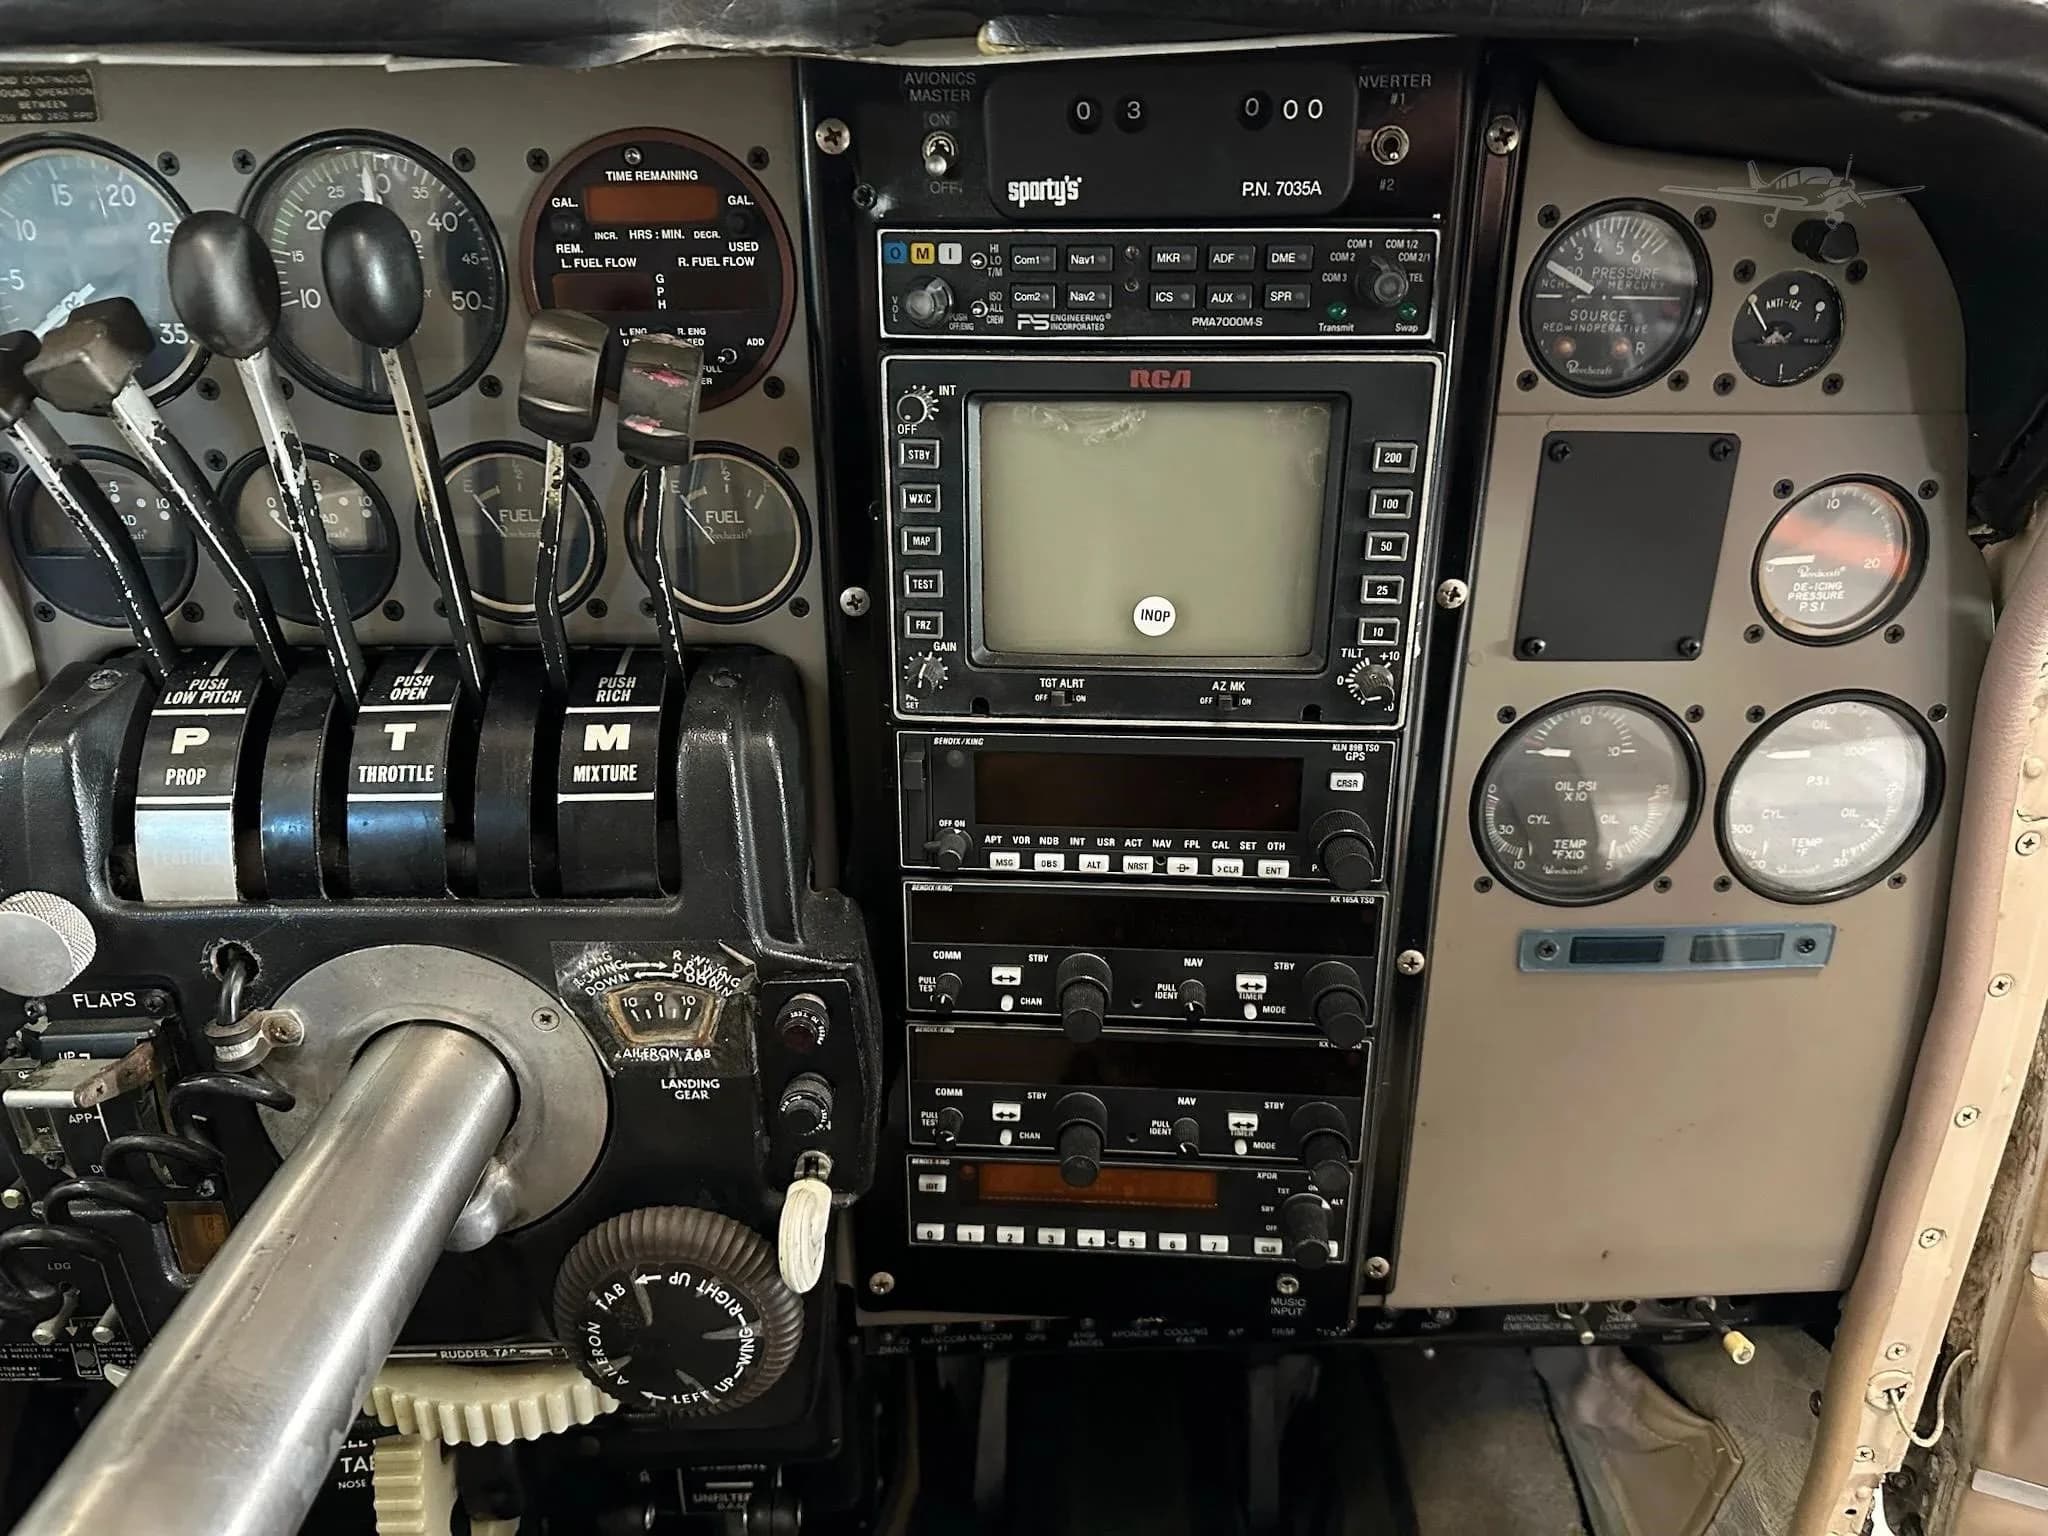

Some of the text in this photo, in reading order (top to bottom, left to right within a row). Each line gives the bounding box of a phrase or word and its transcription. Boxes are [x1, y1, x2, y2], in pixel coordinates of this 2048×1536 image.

[904, 72, 976, 85] AVIONICS
[1358, 74, 1432, 89] NVERTER
[909, 89, 971, 103] MASTER
[1127, 101, 1141, 119] 3
[929, 114, 950, 127] ON
[606, 170, 698, 181] TIME REMAINING
[1276, 181, 1322, 196] 7035A
[1379, 178, 1395, 191] #2
[51, 184, 73, 206] 15
[106, 184, 136, 206] 20
[327, 186, 345, 199] 25
[412, 187, 429, 199] 35
[1008, 175, 1082, 208] sporty's
[552, 198, 579, 208] GAL.
[727, 195, 754, 206] GAL.
[427, 212, 458, 232] 40
[16, 220, 37, 241] 10
[629, 229, 686, 240] HRS MIN.
[694, 230, 721, 240] DECR.
[594, 231, 619, 241] INCR.
[556, 244, 584, 254] REM.
[728, 241, 759, 252] USED
[1615, 241, 1625, 255] 5
[292, 251, 304, 262] 15
[461, 253, 480, 265] 45
[1070, 254, 1095, 264] Nav1
[1157, 252, 1180, 263] MKR
[1213, 253, 1234, 263] ADF
[1271, 252, 1295, 263] DME
[1574, 247, 1583, 261] 3
[1631, 251, 1642, 264] 6
[574, 257, 637, 268] FUEL FLOW
[692, 256, 755, 267] FUEL FLOW
[1014, 255, 1040, 265] Com1
[1592, 267, 1662, 280] PRESSURE
[1608, 279, 1665, 290] MERCURY
[300, 288, 321, 309] 10
[451, 291, 481, 311] 50
[1014, 292, 1041, 302] Com2
[1070, 292, 1096, 301] Nav2
[1156, 292, 1174, 302] ICS
[1211, 293, 1233, 303] AUX
[1270, 291, 1292, 301] SPR
[1766, 299, 1802, 311] ANTI-ICE
[1051, 314, 1105, 322] ENGINEERING
[1569, 309, 1628, 322] SOURCE
[1051, 322, 1105, 331] INCORPORATED
[1192, 316, 1263, 327] PMA7000M-S
[688, 327, 706, 336] ENG
[1318, 322, 1354, 332] Transmit
[1395, 323, 1419, 333] Swap
[160, 323, 190, 345] 35
[746, 338, 765, 346] ADD
[1130, 369, 1192, 389] RCA
[938, 385, 957, 396] INT
[897, 424, 917, 435] OFF
[908, 450, 931, 460] STBY
[1384, 452, 1402, 463] 200
[1382, 499, 1398, 509] 100
[499, 510, 539, 523] FUEL
[705, 511, 744, 524] FUEL
[912, 536, 931, 546] MAP
[1380, 541, 1392, 552] 50
[1863, 559, 1880, 569] 20
[912, 580, 934, 590] TEST
[1793, 582, 1843, 592] DE-ICING
[1376, 586, 1388, 595] 25
[1788, 591, 1845, 600] PRESSURE
[1140, 608, 1171, 623] INOP
[915, 620, 932, 630] FRZ
[1373, 627, 1384, 637] 10
[933, 642, 957, 652] GAIN
[1341, 648, 1363, 658] TILT
[188, 678, 229, 691] PUSH
[393, 675, 434, 687] PUSH
[598, 676, 636, 689] PUSH
[1039, 678, 1085, 689] TGT ALRT
[1212, 681, 1245, 692] AZ MK
[164, 690, 243, 704] LOW PITCH
[390, 687, 433, 701] OPEN
[596, 689, 632, 702] RICH
[171, 727, 210, 754] P
[384, 723, 417, 751] T
[584, 724, 631, 750] M
[934, 737, 984, 746] BENDIX/KING
[1345, 752, 1366, 761] GPS
[165, 768, 207, 785] PROP
[358, 765, 435, 783] THROTTLE
[573, 764, 638, 782] MIXTURE
[1555, 781, 1597, 791] OIL PSI
[1761, 809, 1784, 819] CYL
[1527, 814, 1550, 825] CYL
[984, 835, 1002, 844] APT
[1013, 836, 1031, 845] VOR
[1039, 836, 1059, 846] NDB
[1070, 837, 1086, 846] INT
[1097, 837, 1115, 847] USR
[1124, 838, 1143, 847] ACT
[1153, 839, 1172, 848] NAV
[1184, 839, 1200, 849] FPL
[1554, 839, 1587, 849] TEMP
[1212, 840, 1230, 850] CAL
[1240, 841, 1257, 850] SET
[1267, 841, 1286, 851] OTH
[933, 951, 961, 960] COMM
[1028, 954, 1049, 963] STBY
[1184, 958, 1203, 967] NAV
[1274, 962, 1295, 971] STBY
[918, 976, 937, 985] PULL
[1157, 983, 1176, 992] PULL
[72, 992, 137, 1009] FLAPS
[1155, 991, 1178, 1000] IDENT
[1020, 997, 1042, 1006] CHAN
[1262, 1005, 1286, 1014] MODE
[661, 1078, 720, 1090] LANDING
[675, 1090, 710, 1100] GEAR
[935, 1088, 963, 1097] COMM
[1027, 1091, 1047, 1100] STBY
[1177, 1097, 1196, 1106] NAV
[1264, 1101, 1285, 1110] STBY
[68, 1113, 93, 1124] APP
[1019, 1131, 1041, 1140] CHAN
[47, 1262, 72, 1271] LDG
[595, 1282, 626, 1312] TAB
[696, 1279, 743, 1317] RIGHT
[1270, 1298, 1306, 1307] MUSIC
[1270, 1307, 1302, 1316] INPUT
[440, 1349, 489, 1360] RUDDER
[338, 1480, 366, 1489] NOSE
